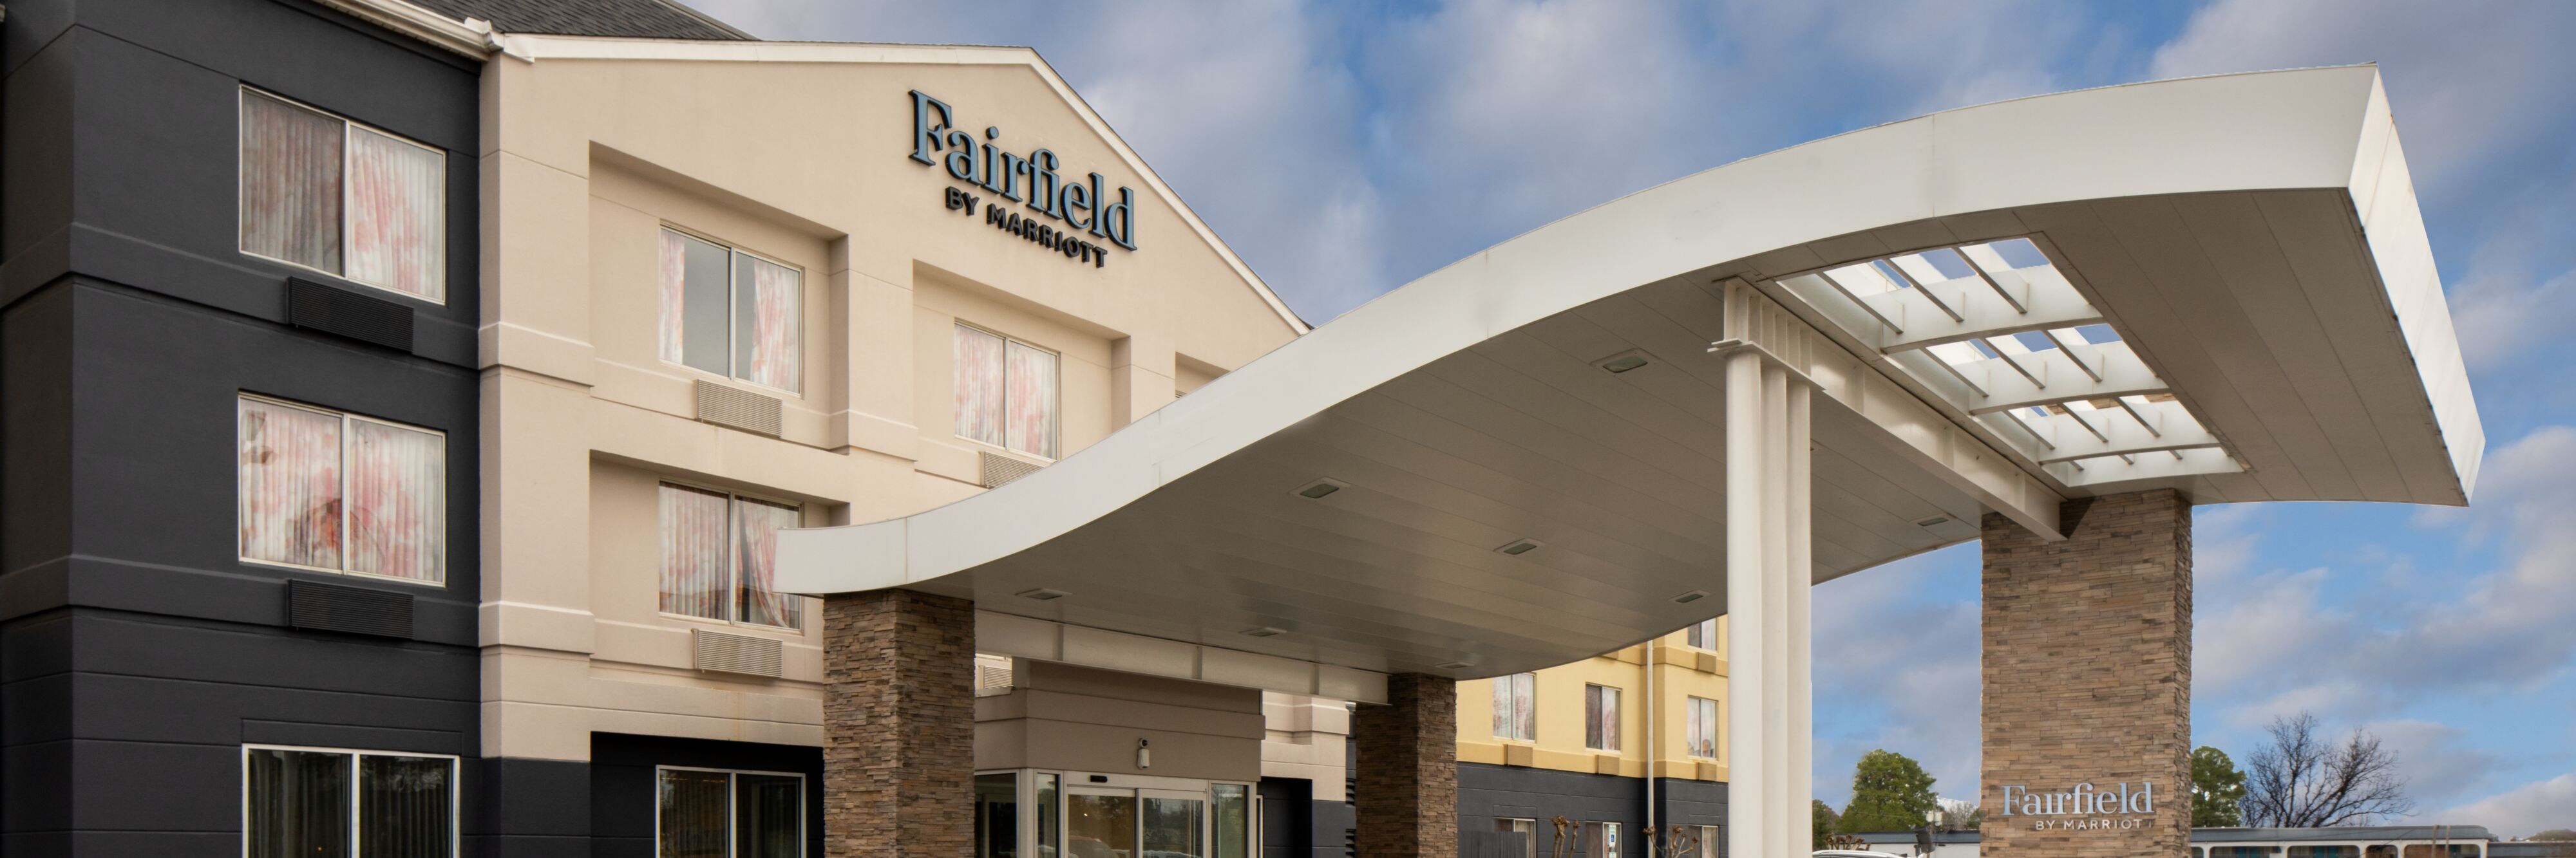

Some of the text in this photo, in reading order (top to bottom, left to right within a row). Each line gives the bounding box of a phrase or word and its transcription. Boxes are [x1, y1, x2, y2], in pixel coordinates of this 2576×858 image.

[909, 89, 1137, 251] Fairfield
[945, 186, 1108, 268] BY MARRIOTT
[2001, 781, 2155, 816] Fairfield
[2036, 820, 2056, 830] BY
